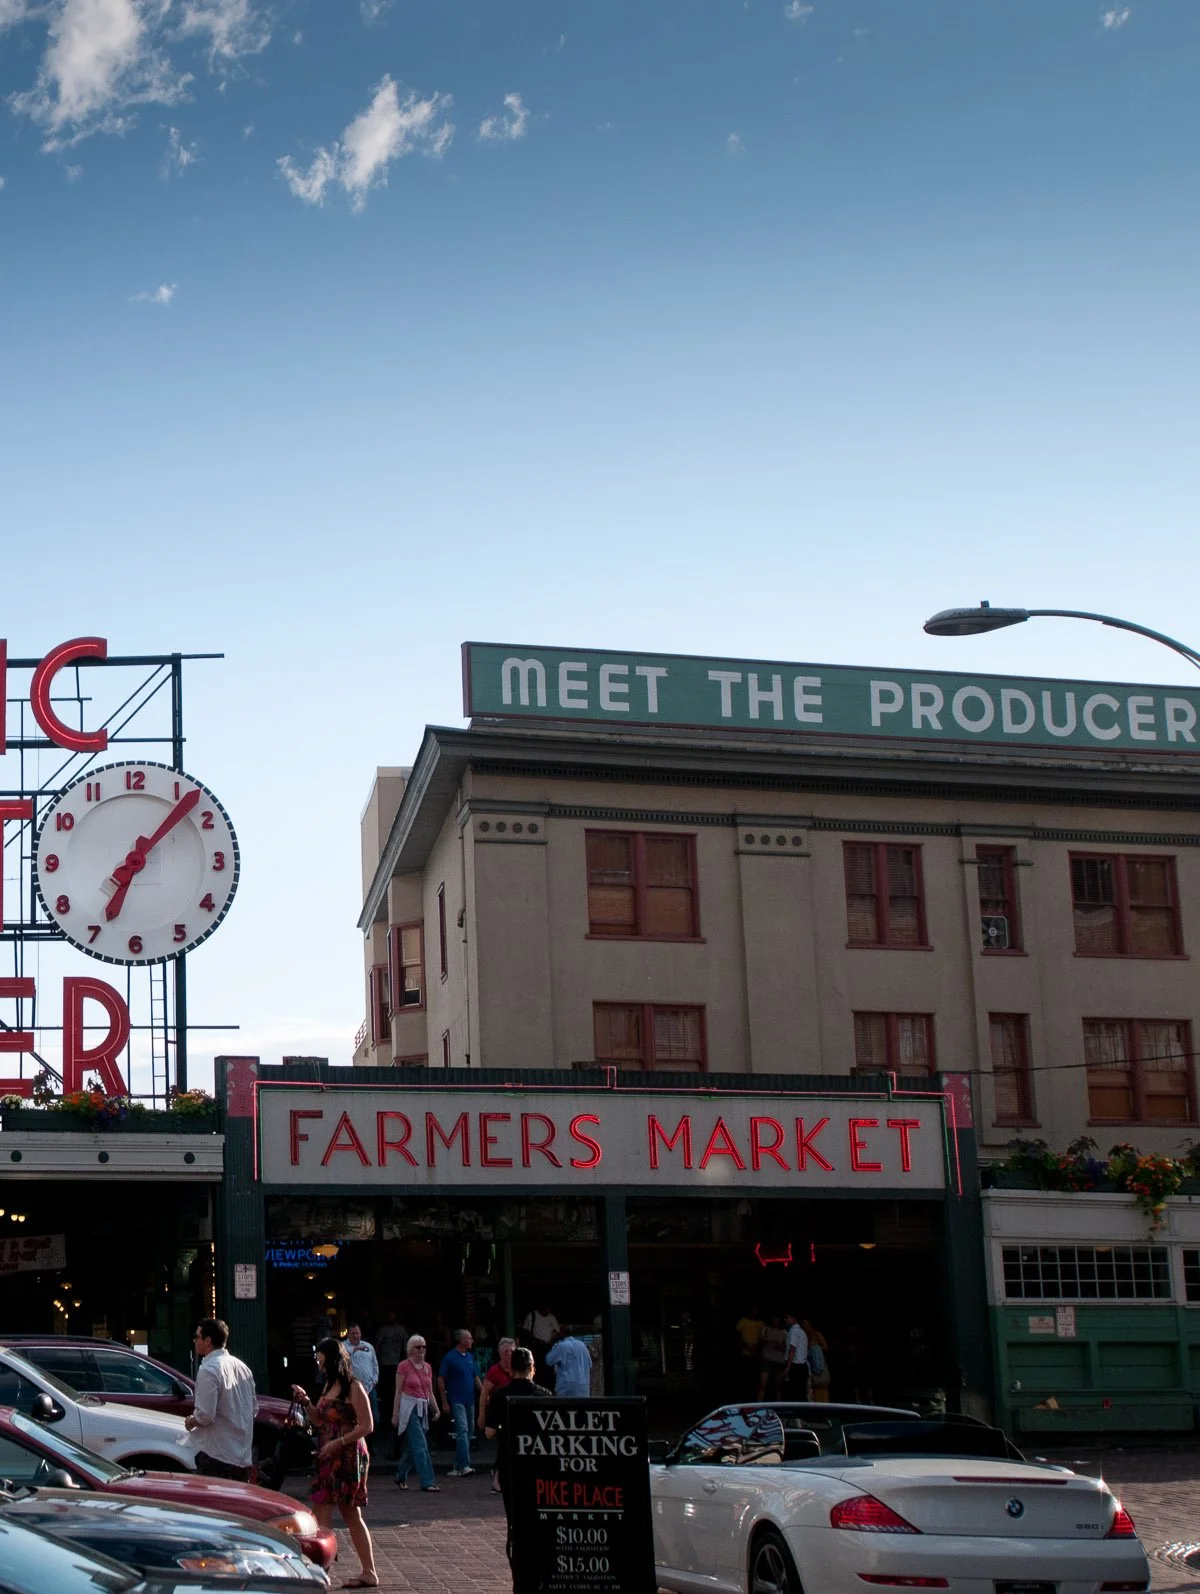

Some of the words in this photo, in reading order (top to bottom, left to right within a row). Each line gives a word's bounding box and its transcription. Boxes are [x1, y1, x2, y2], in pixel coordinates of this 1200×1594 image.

[501, 657, 668, 713] MEET
[708, 670, 823, 723] THE
[870, 680, 1197, 743] PRODUCER
[126, 771, 145, 790] 12
[87, 783, 100, 802] 11
[174, 782, 180, 800] 1
[56, 812, 74, 831] 10
[202, 811, 214, 829] 2
[45, 854, 59, 872] 9
[212, 852, 225, 871] 3
[56, 895, 70, 914] 8
[199, 893, 215, 912] 4
[88, 925, 101, 943] 7
[173, 924, 186, 943] 5
[128, 935, 143, 954] 6
[289, 1110, 602, 1169] FARMERS
[648, 1115, 921, 1173] MARKET
[532, 1410, 621, 1431] VALET
[517, 1434, 638, 1456] PARKING
[560, 1457, 598, 1472] FOR
[536, 1478, 569, 1506] PIKE
[573, 1482, 624, 1507] PLACE
[540, 1512, 623, 1520] MARKET
[556, 1525, 608, 1544] $10.00
[557, 1554, 610, 1573] $15.00
